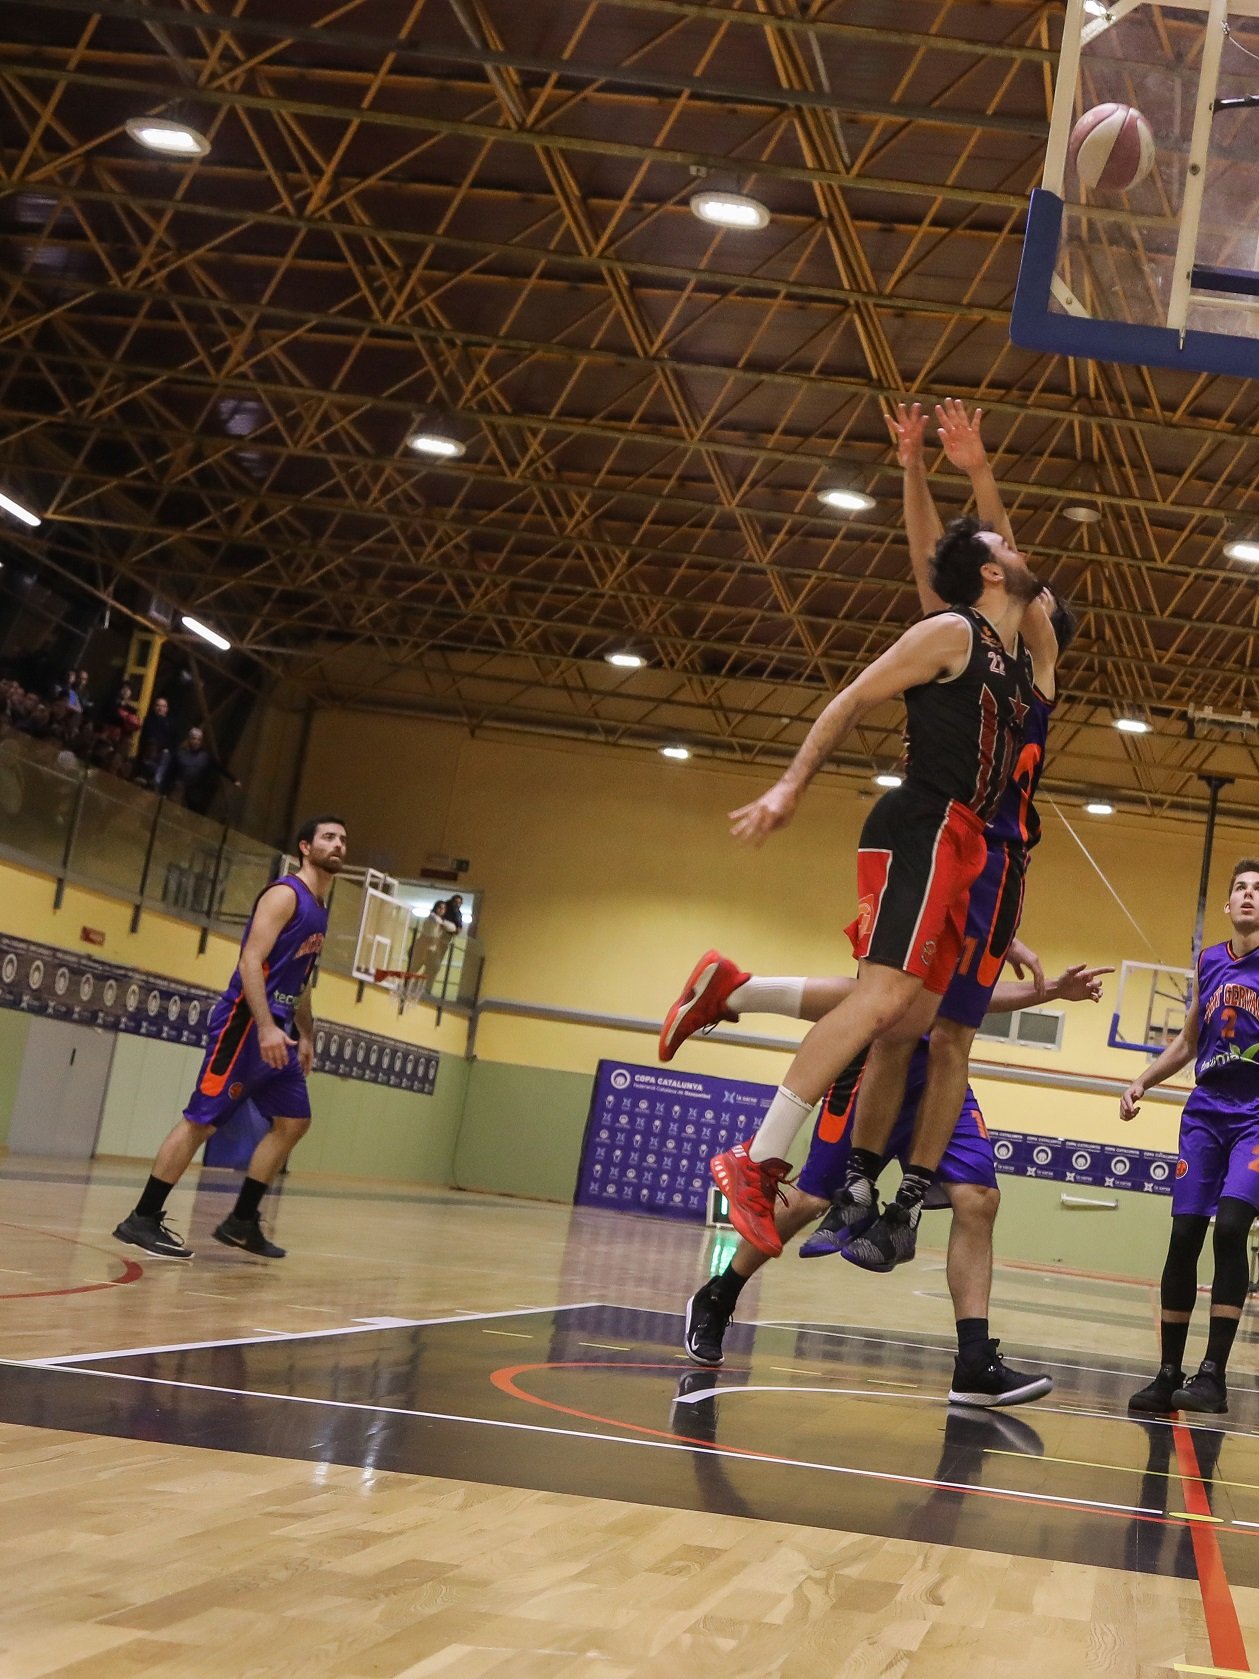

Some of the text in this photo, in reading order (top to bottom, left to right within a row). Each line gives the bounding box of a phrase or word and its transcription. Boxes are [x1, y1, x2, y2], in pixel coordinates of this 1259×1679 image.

[1221, 1008, 1237, 1038] 2
[634, 1074, 703, 1091] COPA CATALUNYA
